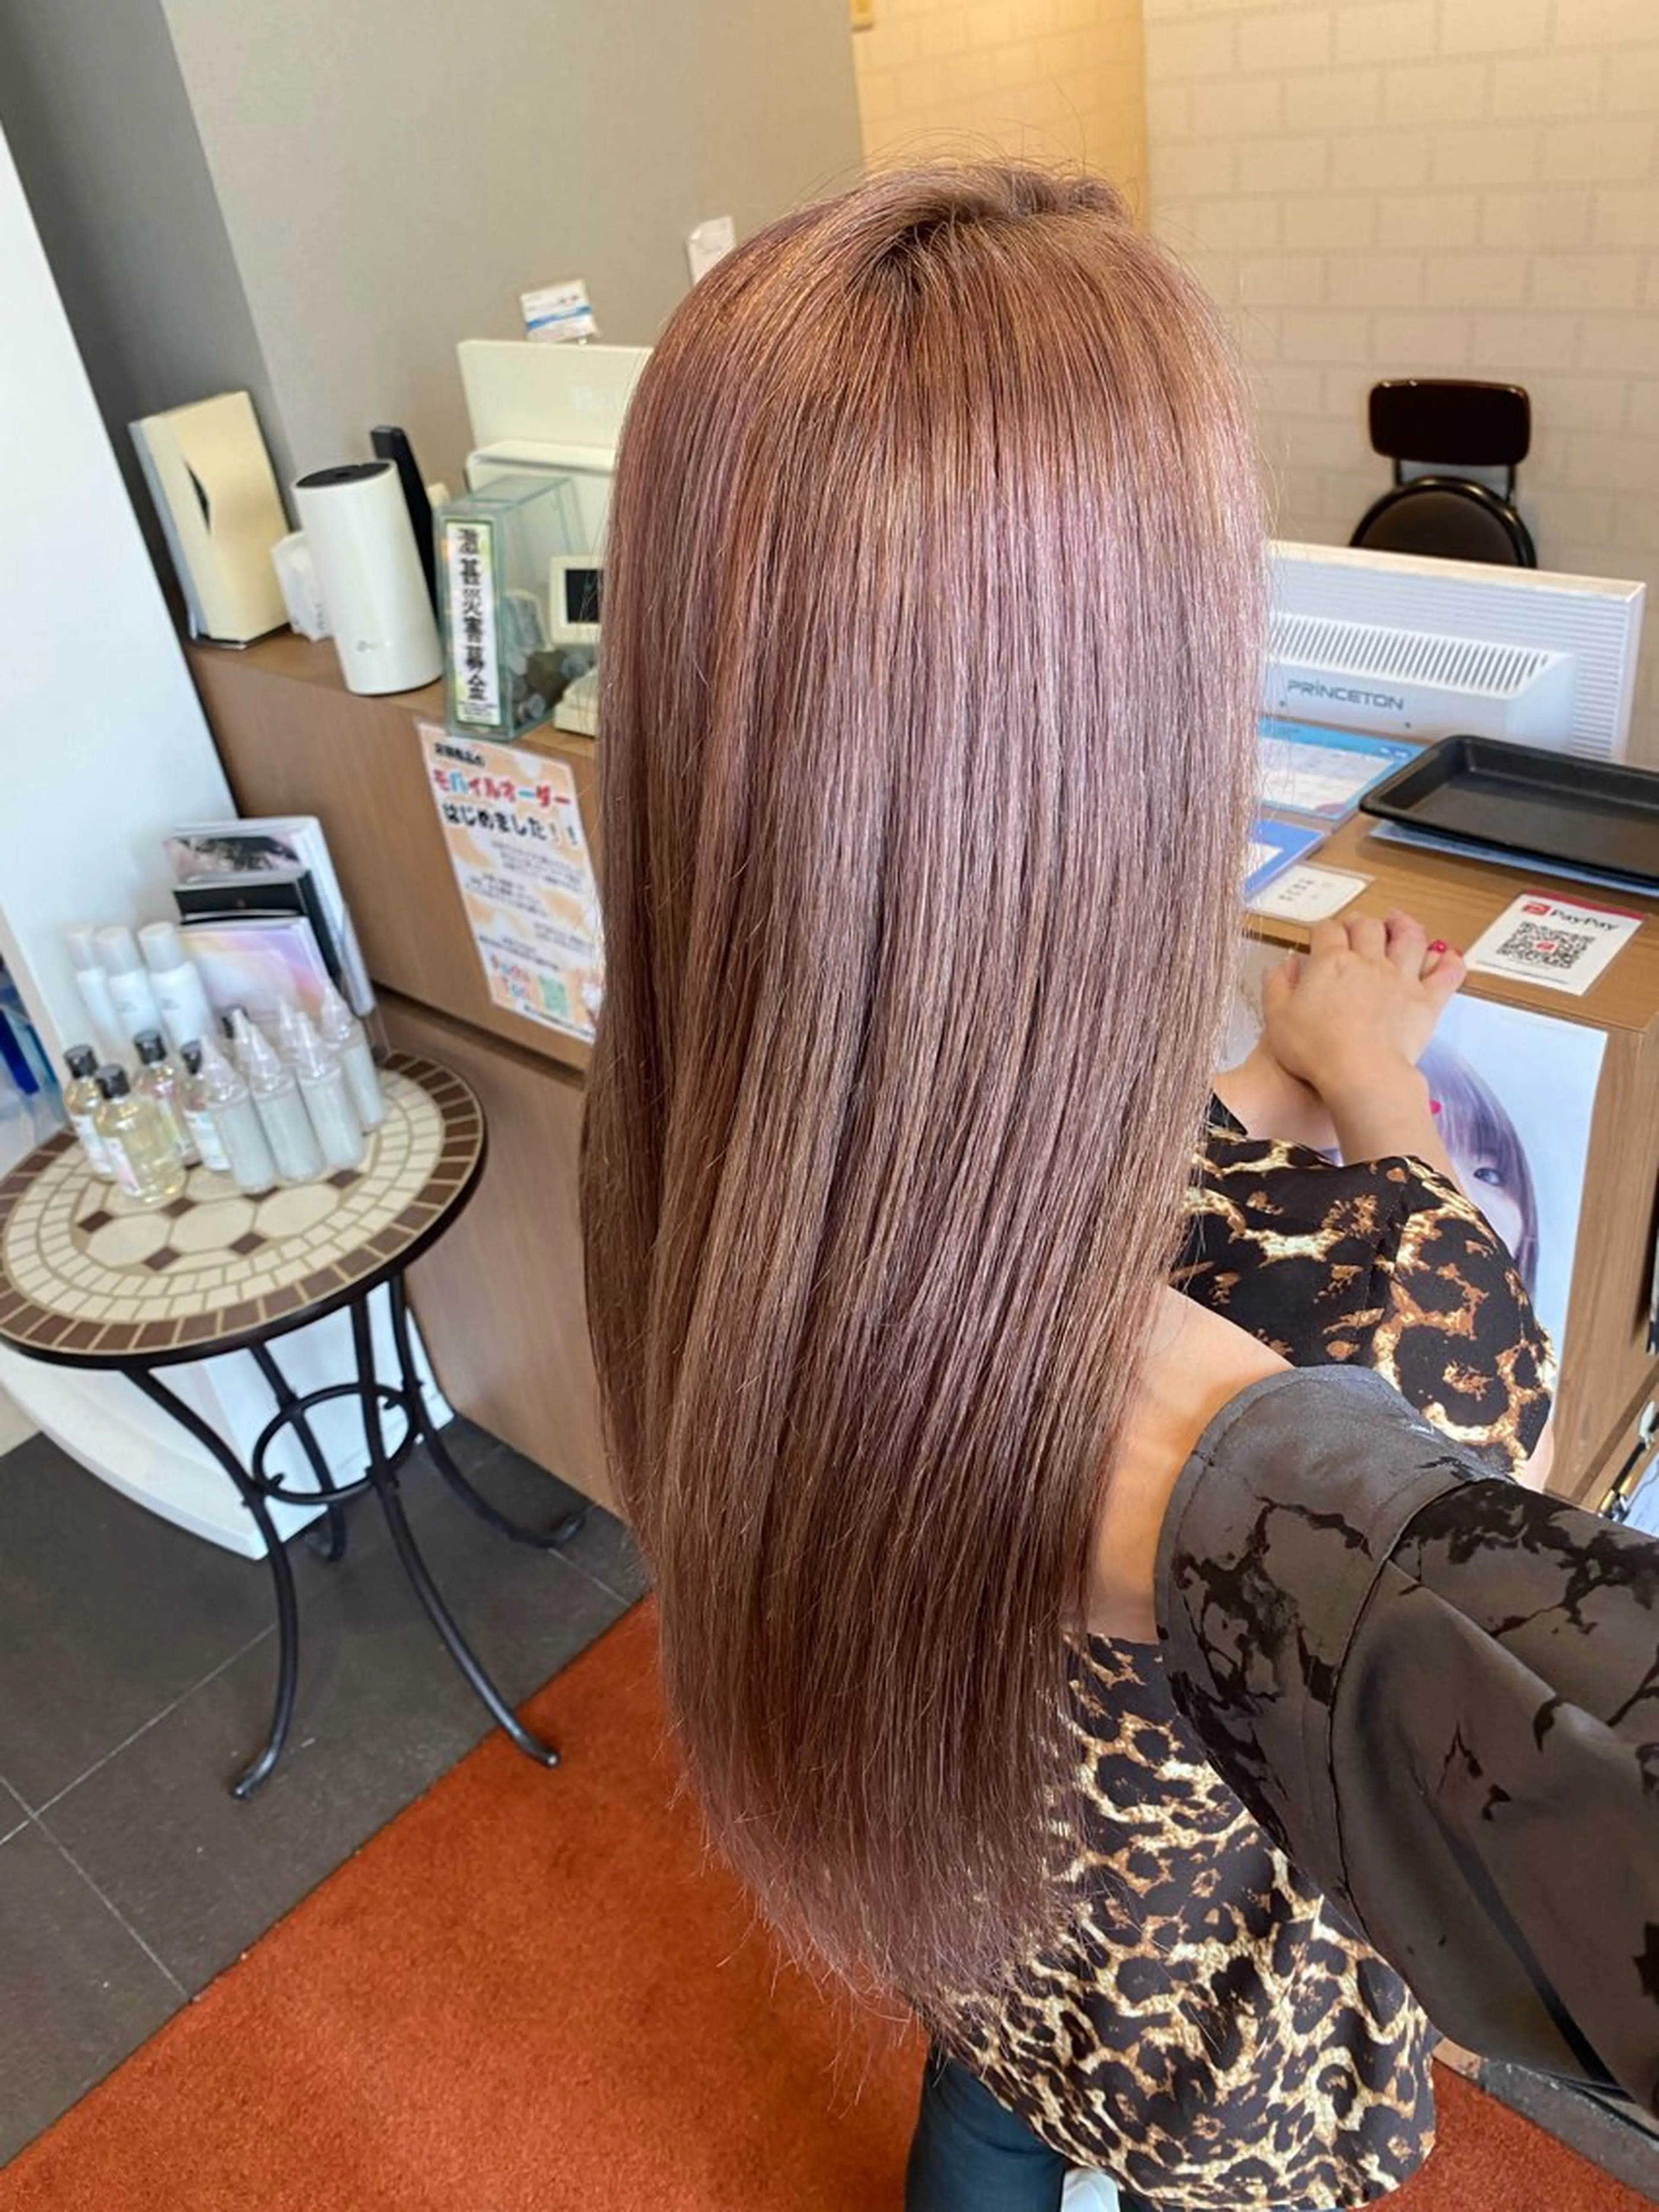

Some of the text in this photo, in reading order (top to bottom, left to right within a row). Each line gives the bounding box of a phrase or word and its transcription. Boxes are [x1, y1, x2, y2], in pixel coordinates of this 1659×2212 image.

[434, 769, 570, 807] モバイルオーダー
[1550, 909, 1620, 931] PayPay
